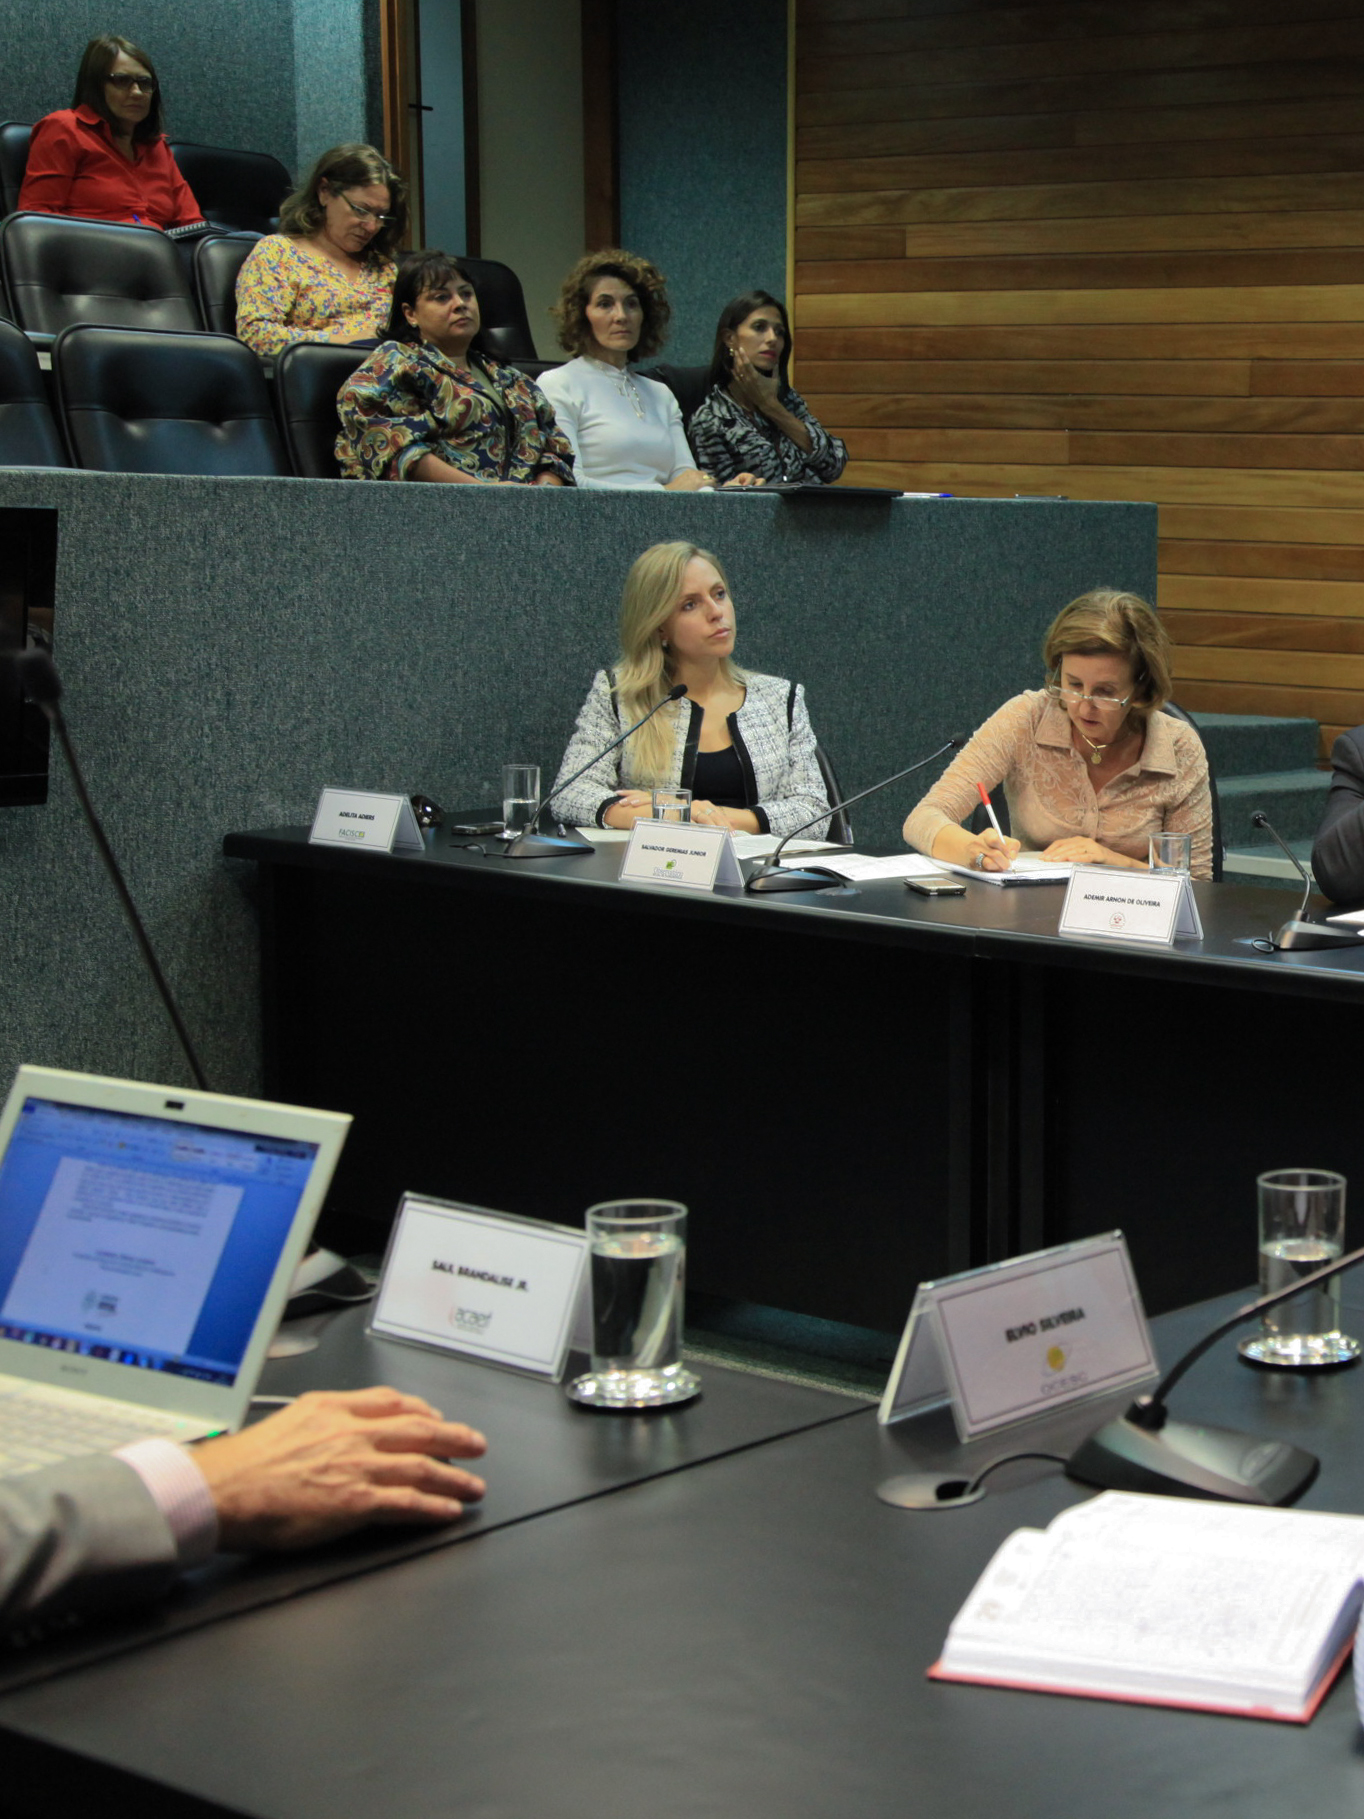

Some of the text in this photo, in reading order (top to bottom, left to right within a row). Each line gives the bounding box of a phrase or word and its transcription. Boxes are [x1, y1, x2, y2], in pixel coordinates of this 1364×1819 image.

[641, 844, 665, 852] SALVADOR
[1084, 893, 1105, 902] ADEMIR
[1106, 895, 1126, 904] ARNON
[1136, 899, 1160, 907] OLIVEIRA
[1040, 1307, 1085, 1332] SILVEIRA
